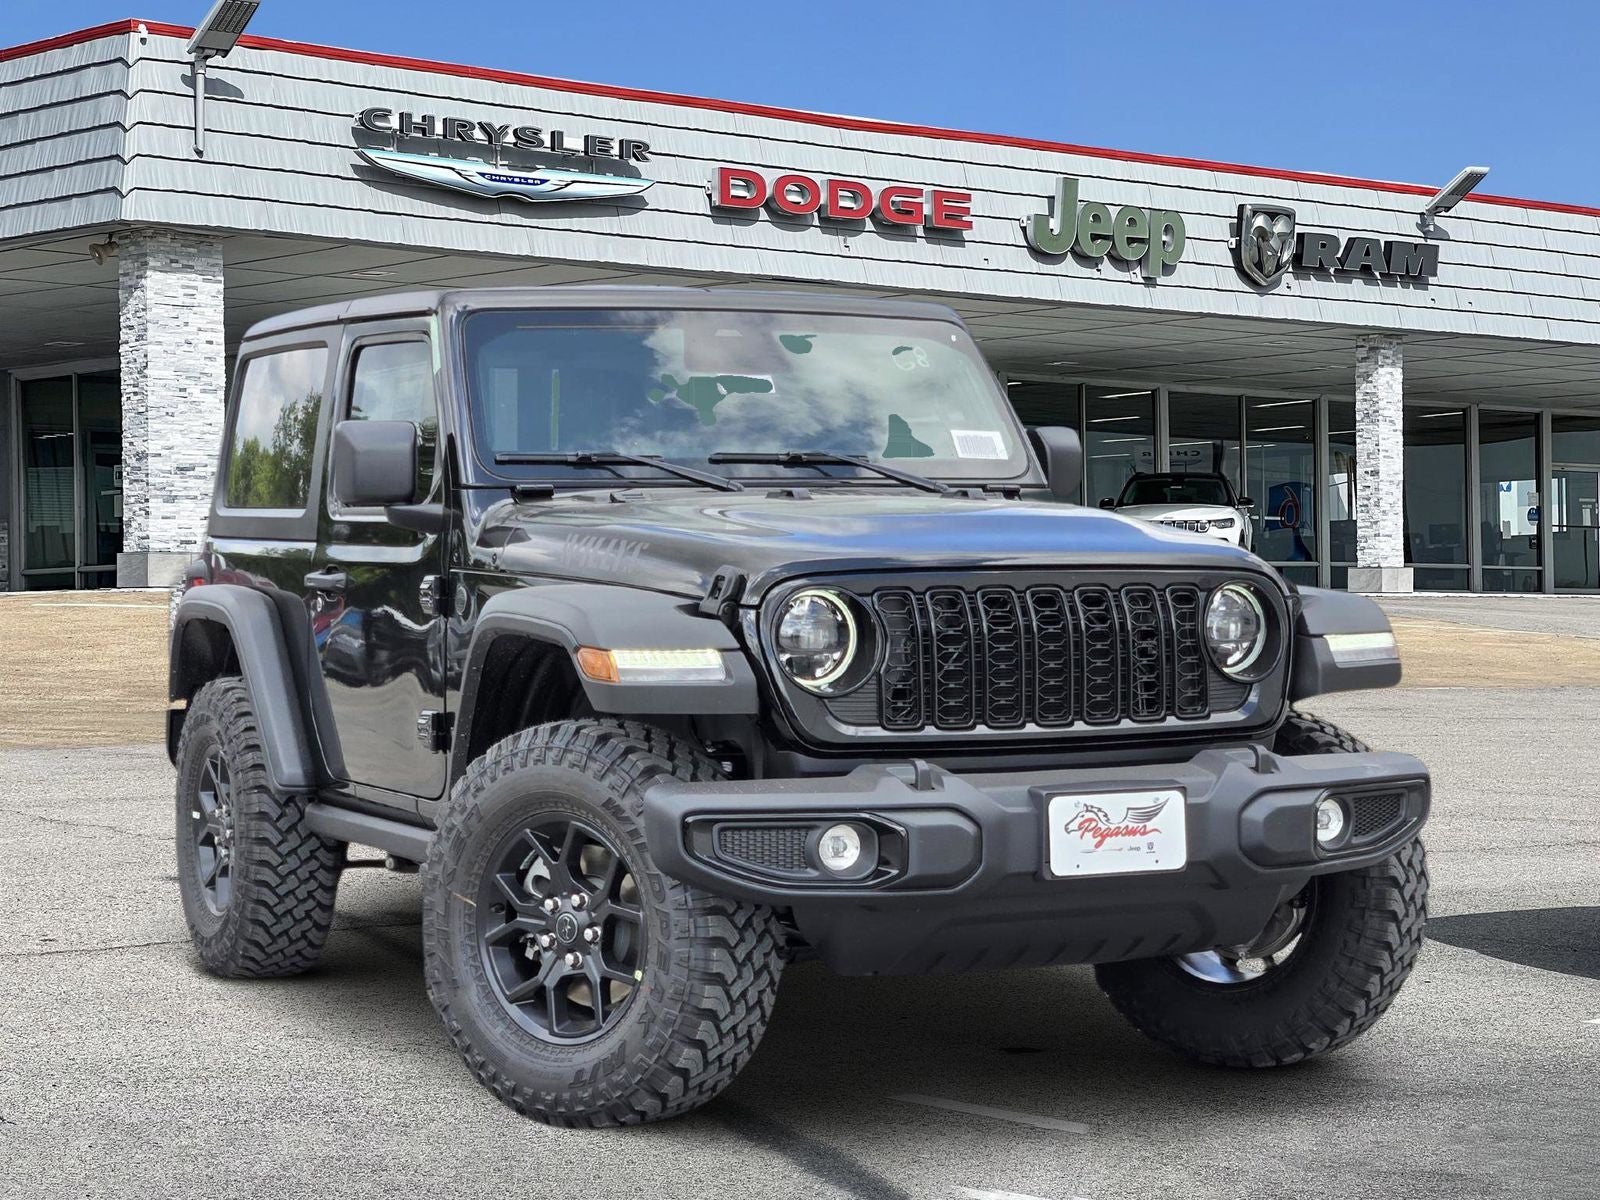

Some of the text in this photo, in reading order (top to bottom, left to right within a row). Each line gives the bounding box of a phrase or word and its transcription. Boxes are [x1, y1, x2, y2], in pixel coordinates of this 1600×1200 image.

[358, 107, 651, 162] CHRYSLER
[484, 174, 541, 185] CHRYSLER
[713, 167, 973, 231] DODGE
[1028, 177, 1186, 279] Jeep
[1298, 232, 1440, 277] RAM
[1077, 817, 1162, 849] Pegasus
